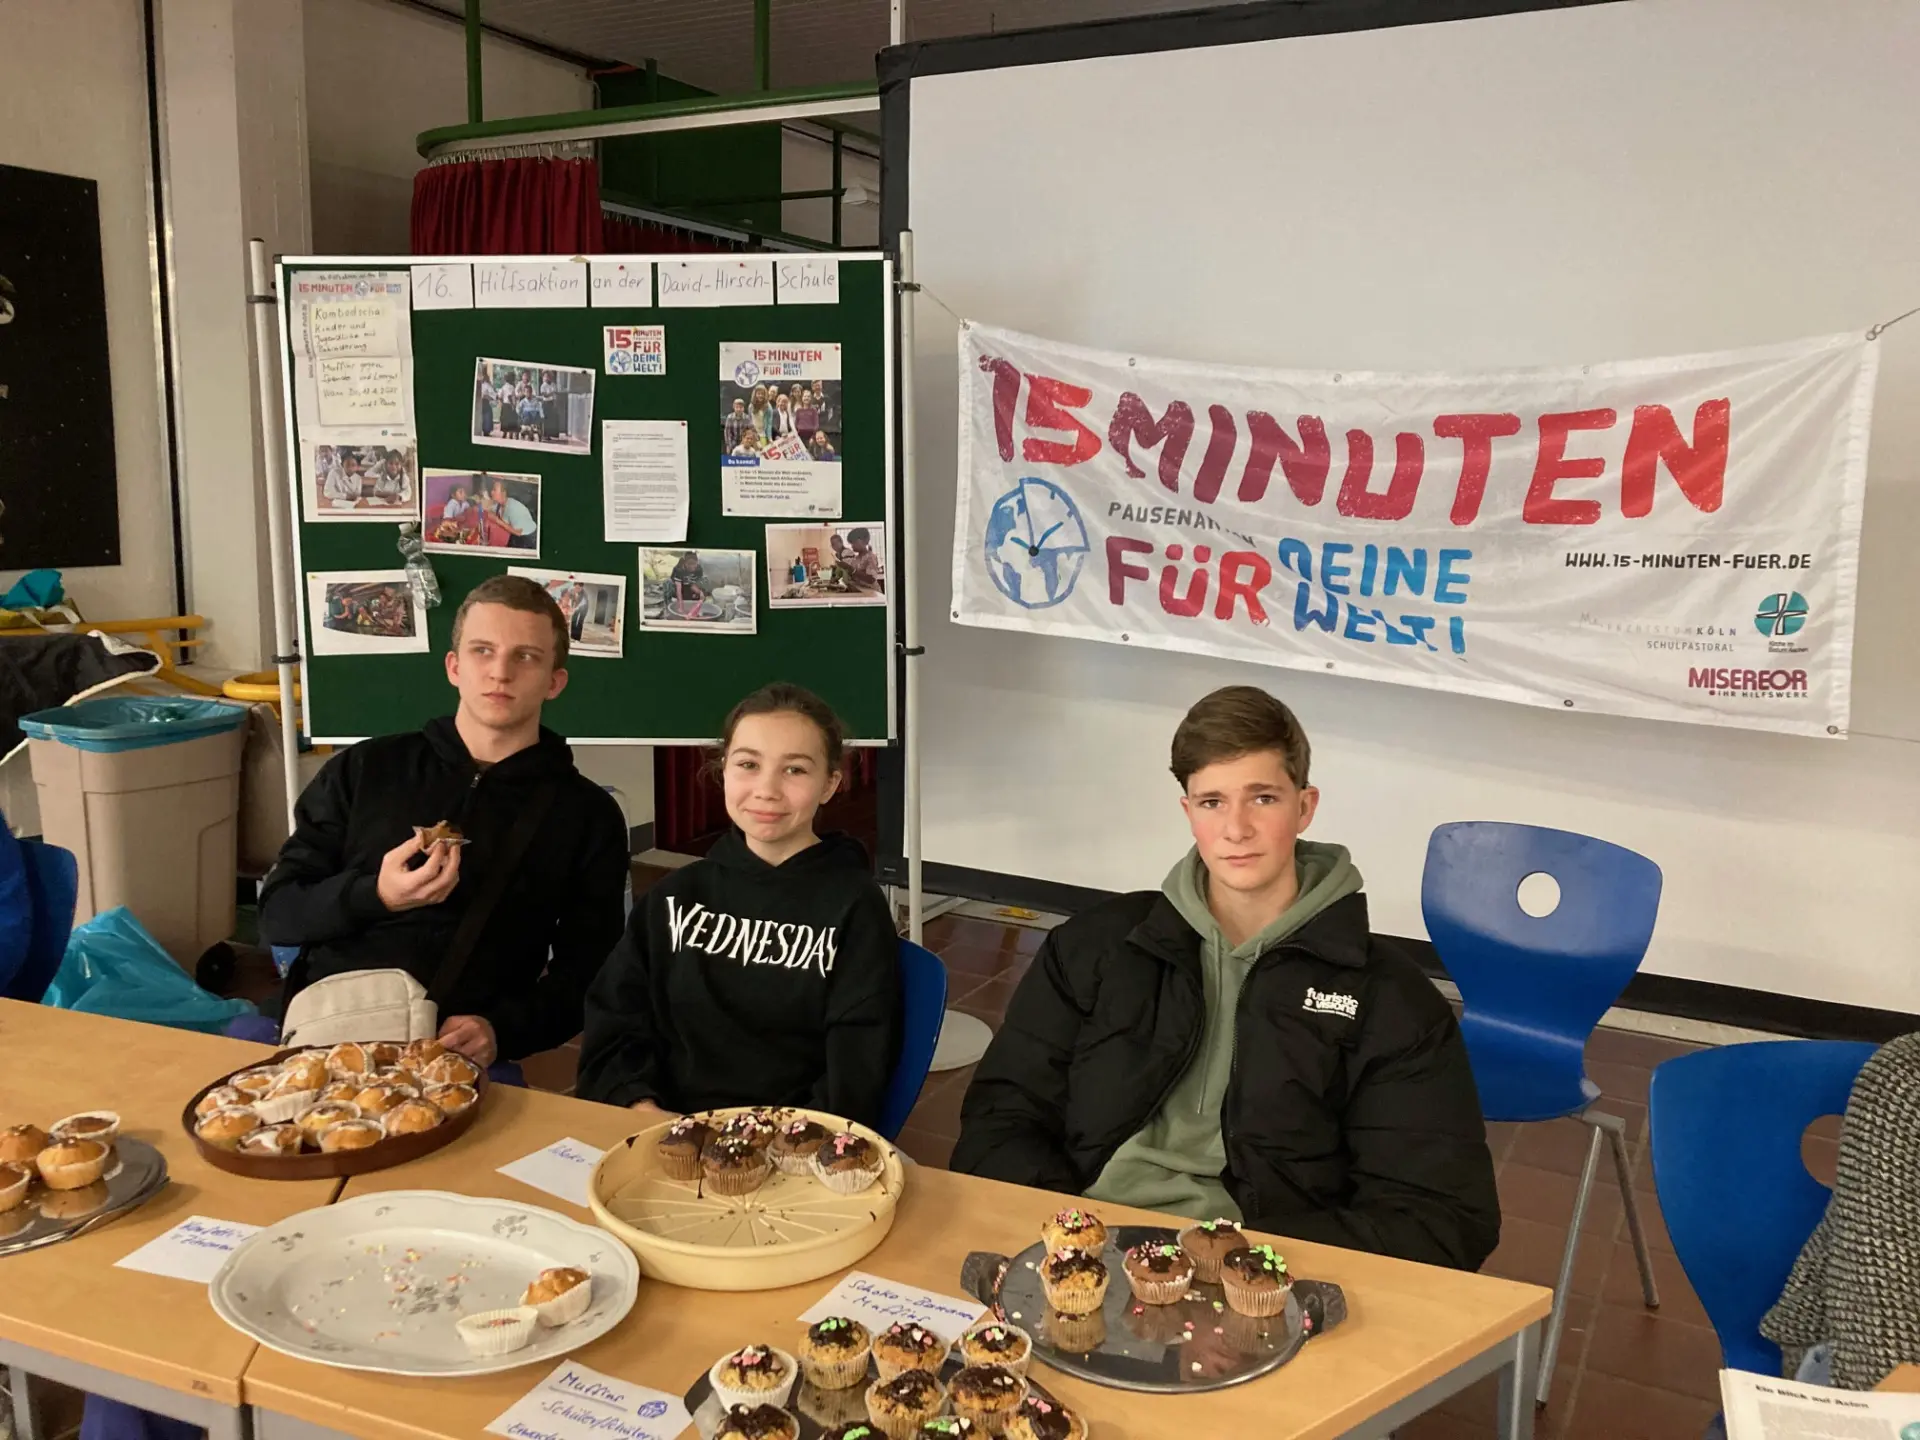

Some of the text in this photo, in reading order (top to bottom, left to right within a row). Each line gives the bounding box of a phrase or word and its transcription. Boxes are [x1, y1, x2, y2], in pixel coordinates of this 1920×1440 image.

[480, 269, 578, 295] Hilfsaktion
[593, 277, 612, 288] an
[618, 272, 644, 288] der
[779, 265, 835, 288] Schule
[311, 284, 353, 293] MINUTEN
[606, 329, 632, 349] 15
[633, 341, 662, 353] FÜR
[633, 354, 662, 363] DEINE
[752, 349, 822, 362] 15 MINUTEN
[633, 364, 662, 373] WELT!
[978, 354, 1731, 526] 15 MINUTEN
[1105, 536, 1473, 626] FÜR DEINE
[1647, 640, 1735, 652] SCHULPASTORAL
[1688, 667, 1808, 692] MISEREOR
[666, 896, 838, 979] WEDNESDAY
